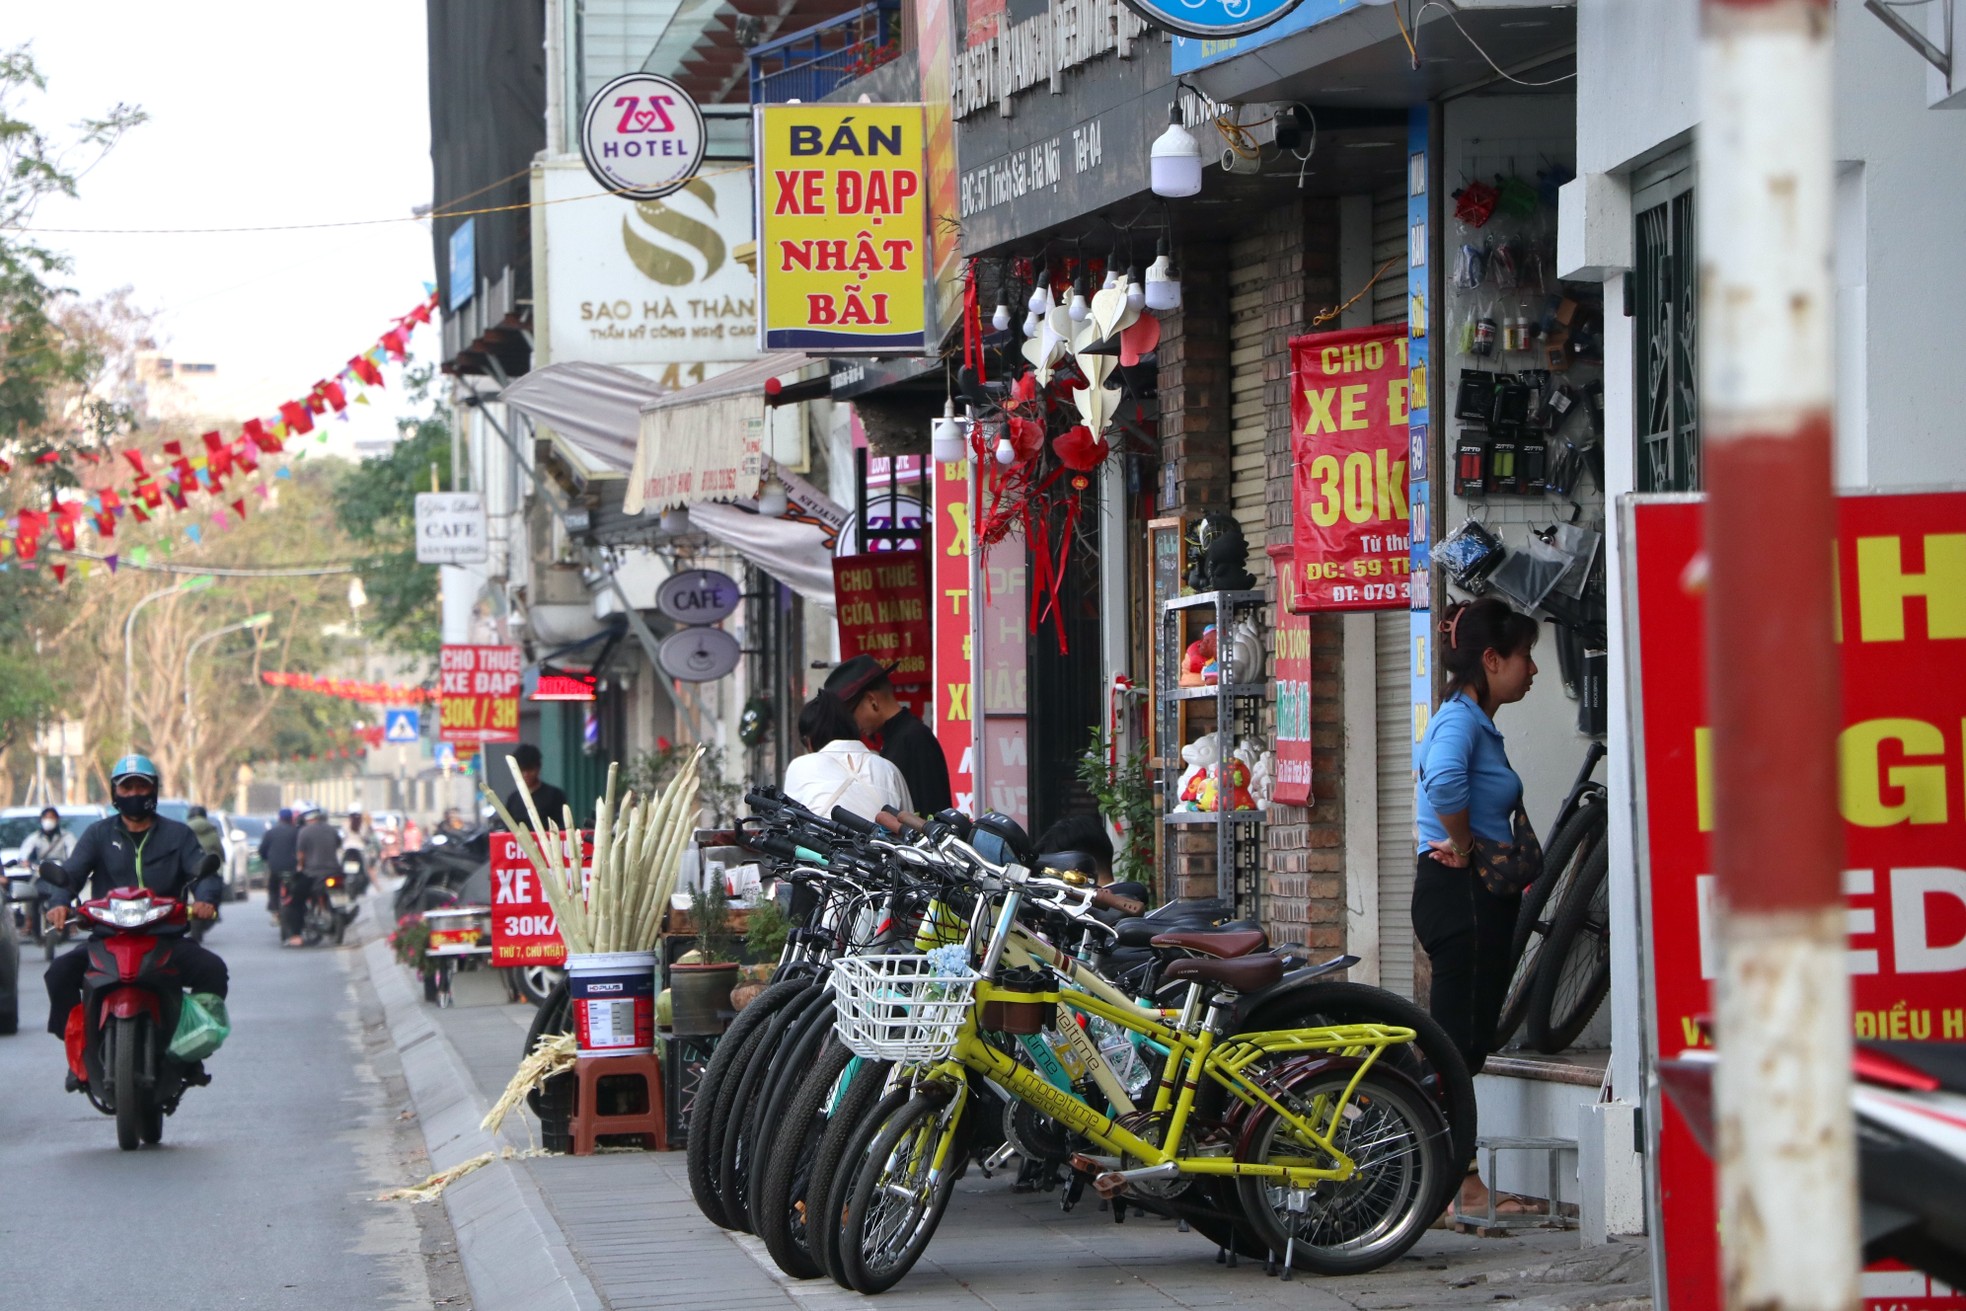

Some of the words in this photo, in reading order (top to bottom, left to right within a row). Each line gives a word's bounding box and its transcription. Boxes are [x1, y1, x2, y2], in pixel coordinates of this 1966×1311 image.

[952, 38, 1000, 120] PEUGEOT
[604, 139, 688, 158] HOTEL
[790, 117, 902, 156] BÁN
[775, 170, 826, 215] XE
[836, 170, 918, 225] ĐẠP
[780, 230, 914, 280] NHẬT
[1411, 215, 1424, 267] BÁN
[580, 301, 632, 320] SAO
[643, 297, 677, 319] HÀ
[807, 284, 889, 325] BÃI
[1321, 341, 1384, 375] CHO
[1303, 384, 1368, 434] XE
[1411, 435, 1423, 471] 59
[1360, 534, 1382, 553] Từ
[841, 570, 872, 592] CHO
[876, 565, 917, 588] THUÊ
[1307, 562, 1345, 581] ĐC:
[1353, 560, 1381, 578] 59
[1333, 586, 1358, 602] ĐT:
[1364, 584, 1396, 601] 079
[842, 597, 873, 627] CỬA
[879, 597, 923, 625] HÀNG
[904, 632, 912, 648] 1
[441, 649, 474, 671] CHO
[443, 673, 469, 693] XE
[475, 672, 518, 697] ĐẠP
[441, 697, 476, 727] 30K
[492, 697, 517, 727] 3H
[496, 869, 531, 904] XE
[1023, 1074, 1099, 1127] modeltime
